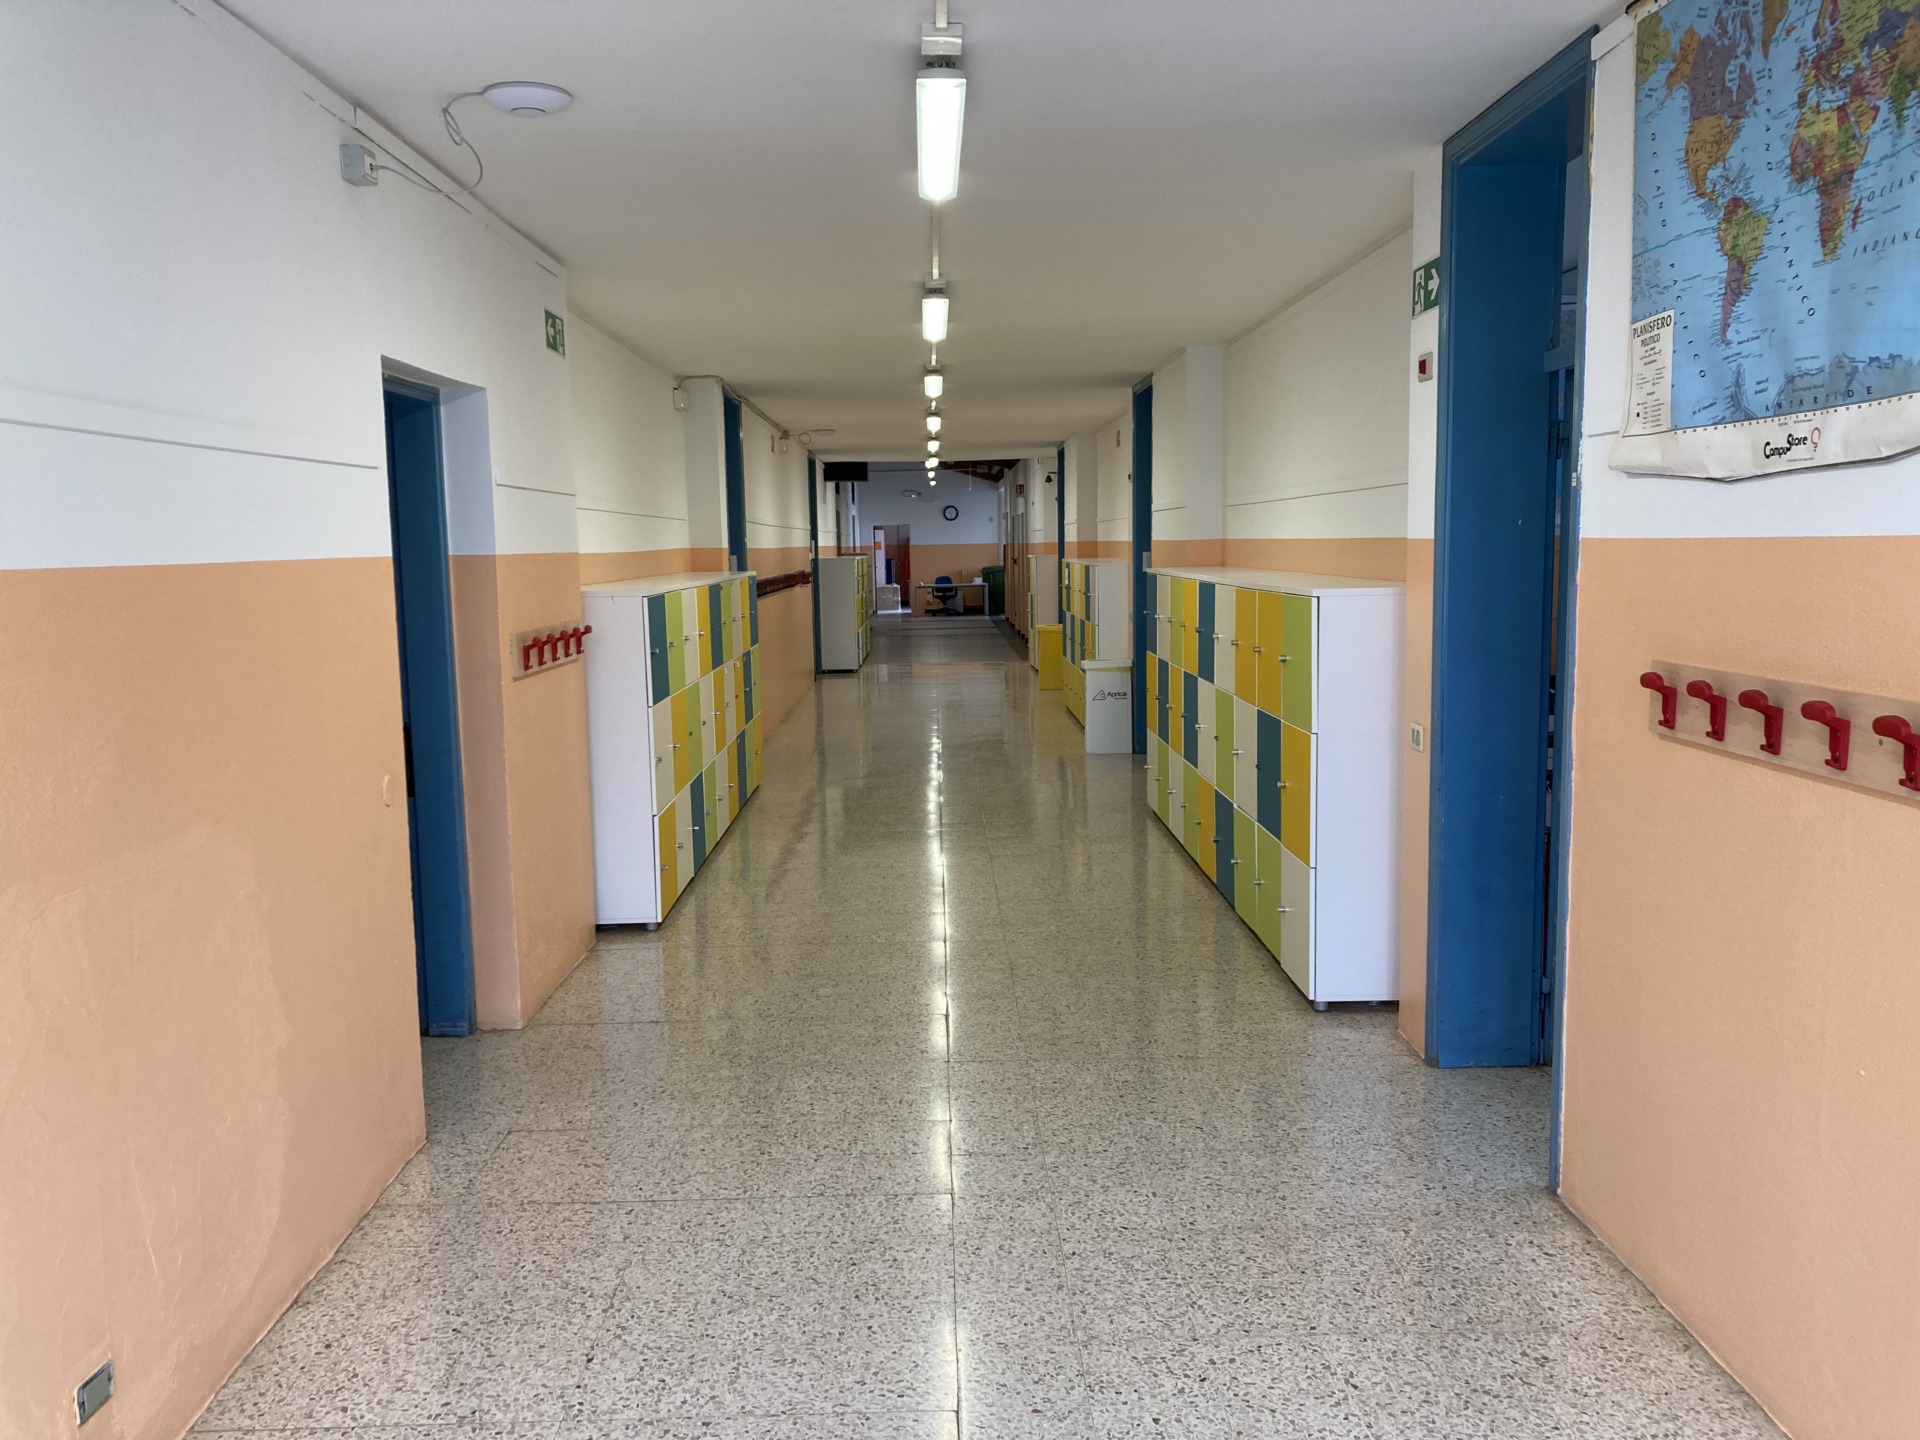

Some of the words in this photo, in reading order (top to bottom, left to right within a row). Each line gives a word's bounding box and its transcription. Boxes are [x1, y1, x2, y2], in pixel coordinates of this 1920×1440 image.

[1633, 314, 1672, 339] PLANISFERO
[1641, 333, 1661, 348] POLITICO
[1765, 385, 1873, 412] ANTARTIDE
